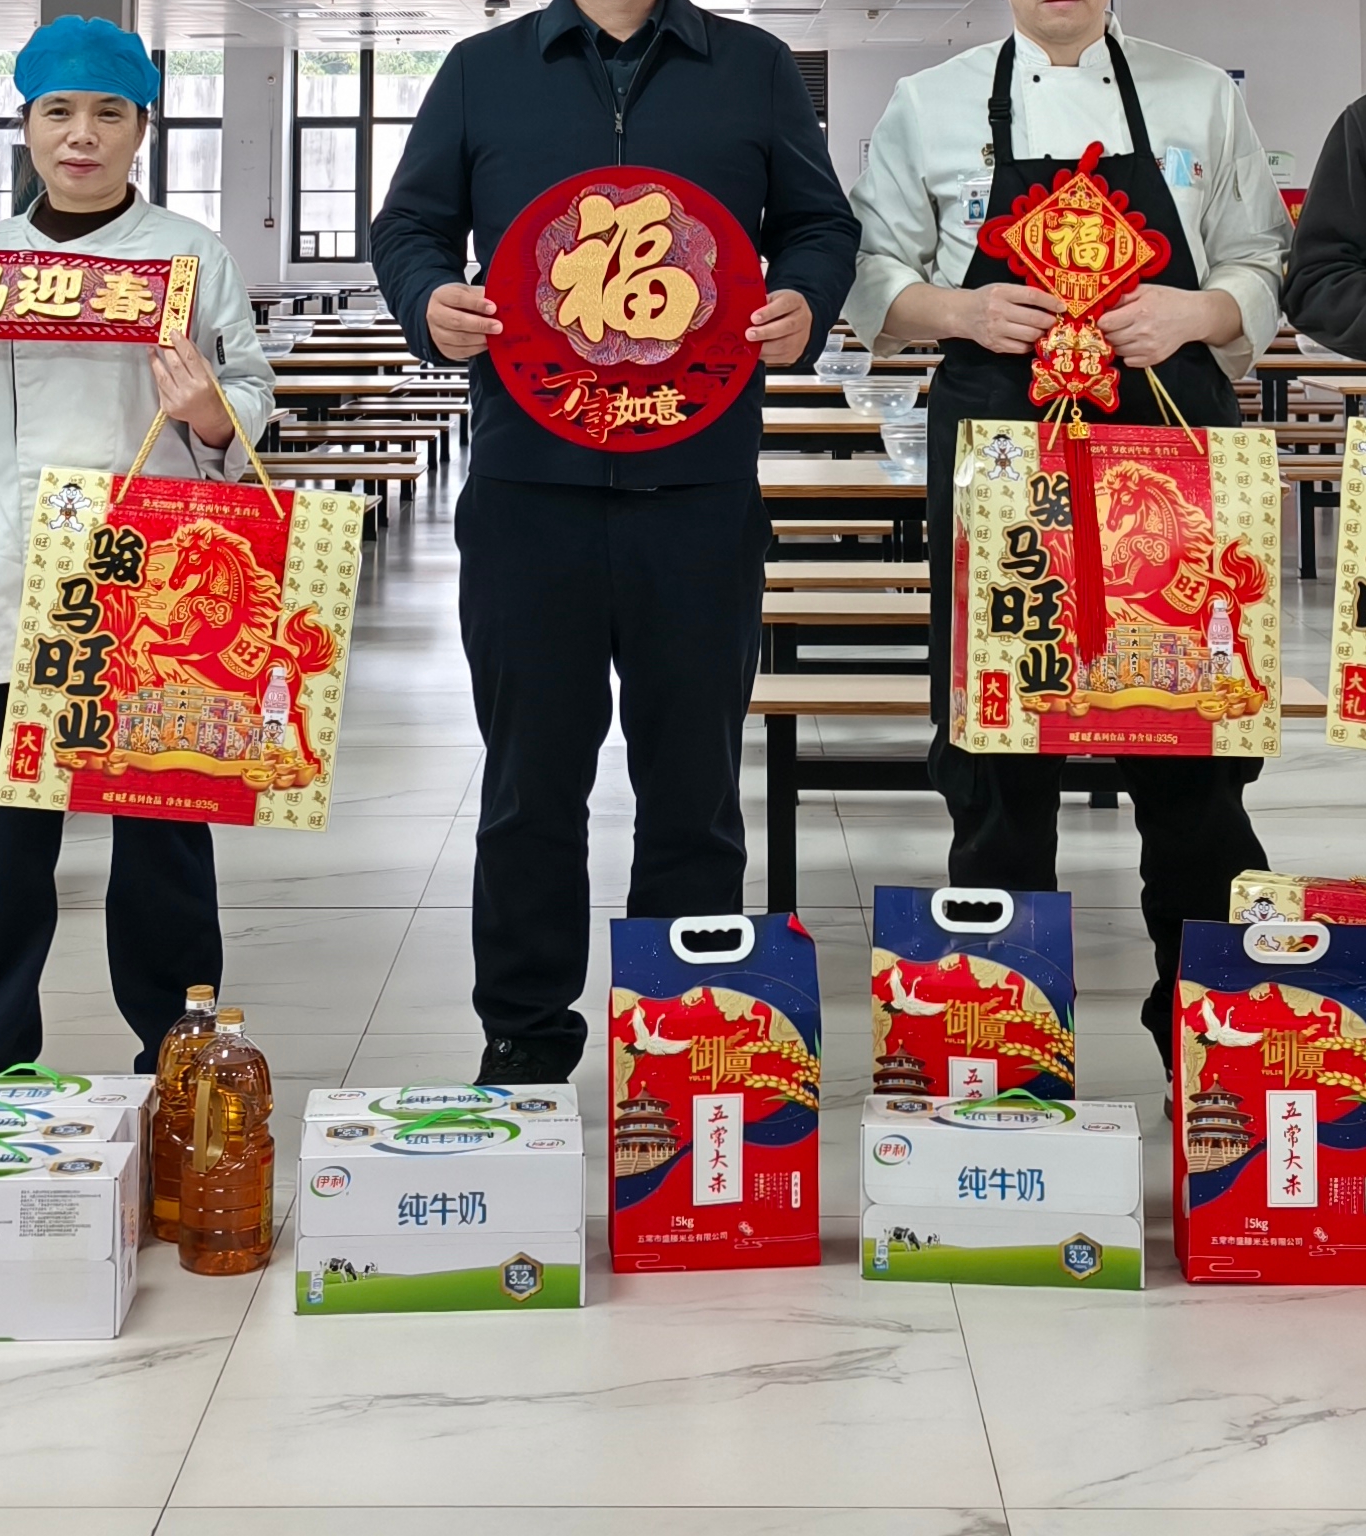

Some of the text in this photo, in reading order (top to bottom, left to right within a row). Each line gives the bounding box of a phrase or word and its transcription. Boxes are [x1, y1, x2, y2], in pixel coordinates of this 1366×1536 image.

[1045, 211, 1109, 271] 福
[550, 192, 701, 343] 福
[541, 370, 688, 444] 万事如意
[321, 499, 337, 513] 旺
[293, 517, 309, 531] 旺
[343, 521, 359, 535] 旺
[34, 535, 50, 549] 旺
[315, 539, 331, 553] 旺
[57, 558, 73, 572] 旺
[288, 558, 304, 572] 旺
[338, 562, 354, 576] 旺
[28, 576, 44, 590] 旺
[310, 581, 326, 595] 旺
[991, 475, 1072, 692] 骏马旺业
[1177, 576, 1205, 600] 旺
[333, 604, 349, 618] 旺
[23, 618, 39, 632] 旺
[33, 528, 146, 751] 骏马旺业
[234, 640, 266, 669] 旺
[17, 660, 33, 674] 旺
[323, 687, 339, 701] 旺
[982, 677, 1007, 723] 大礼
[11, 702, 27, 716] 旺
[318, 729, 334, 743] 旺
[16, 729, 42, 776] 大礼
[0, 787, 16, 801] 旺
[51, 792, 67, 806] 旺
[257, 809, 273, 823] 旺
[308, 813, 324, 827] 旺
[707, 1104, 729, 1194] 五常大米
[878, 1143, 907, 1157] 伊利
[1281, 1101, 1304, 1197] 五常大米
[316, 1175, 346, 1189] 伊利
[958, 1166, 1046, 1202] 纯牛奶
[398, 1191, 487, 1226] 纯牛奶
[675, 1216, 695, 1228] 5kg
[1249, 1218, 1269, 1231] 5kg
[1068, 1250, 1094, 1265] 3.2g
[508, 1271, 535, 1286] 3.2g
